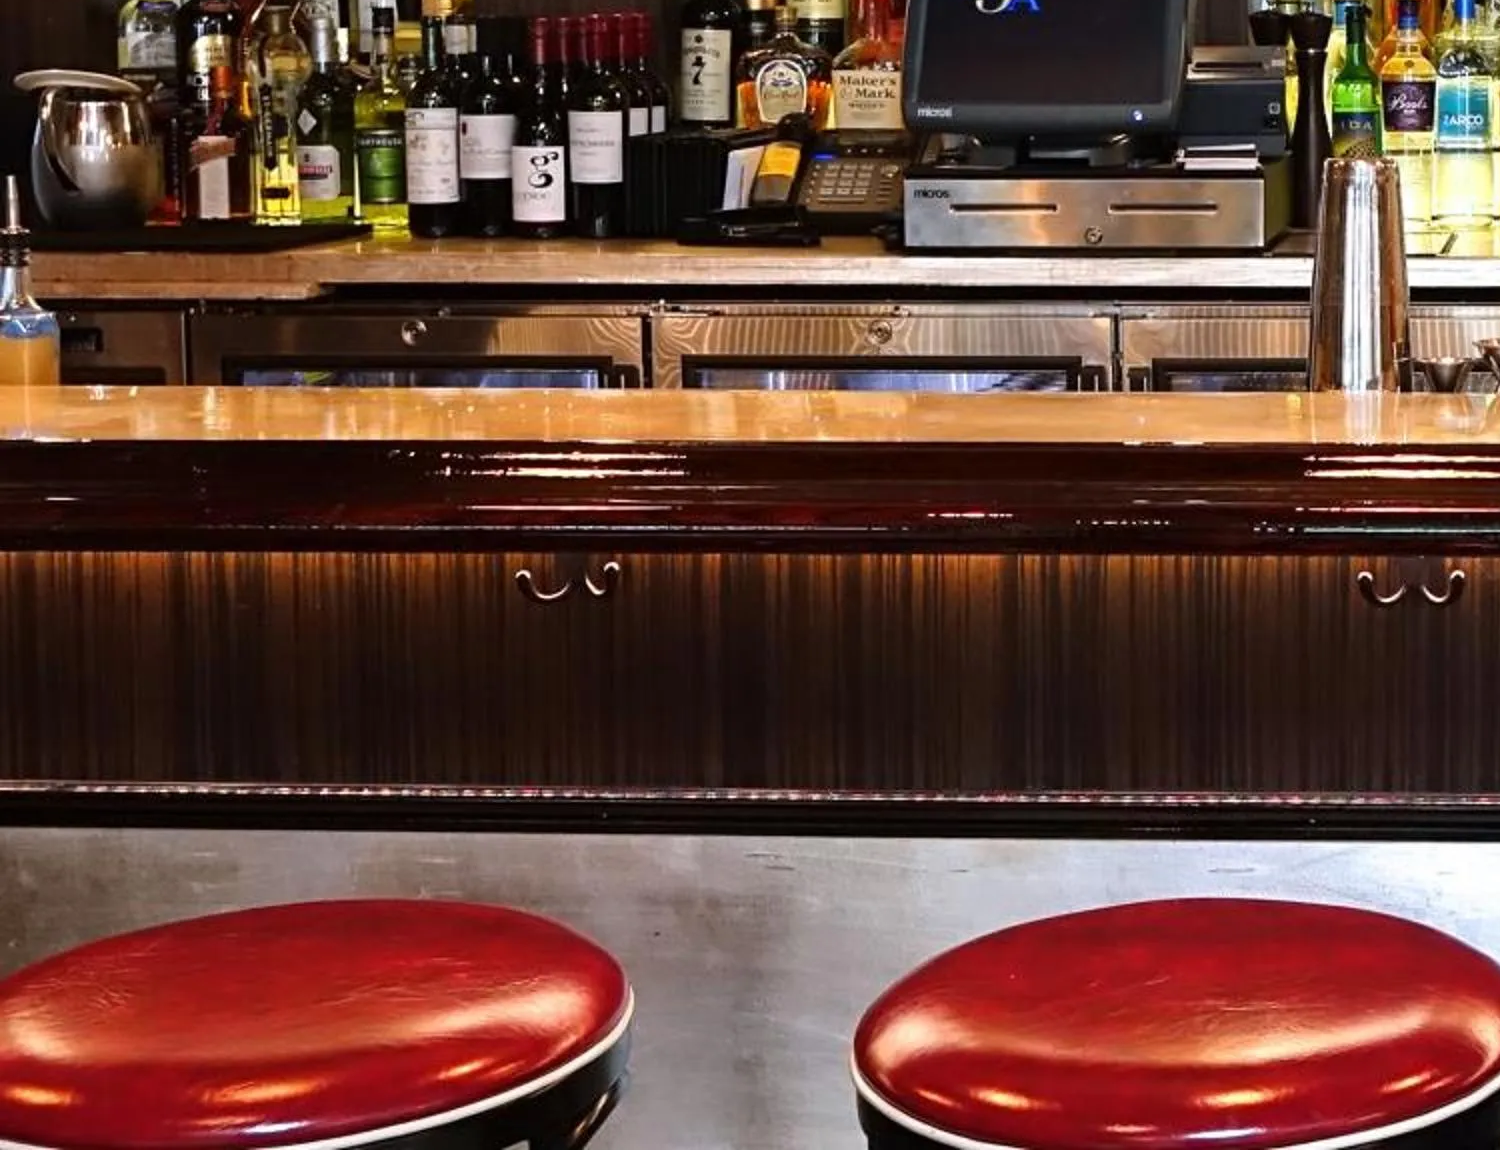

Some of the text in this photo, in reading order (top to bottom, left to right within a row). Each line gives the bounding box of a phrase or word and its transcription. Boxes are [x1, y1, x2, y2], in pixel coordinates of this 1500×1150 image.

[839, 75, 897, 86] Maker's
[917, 106, 953, 118] micros
[914, 187, 950, 200] micros
